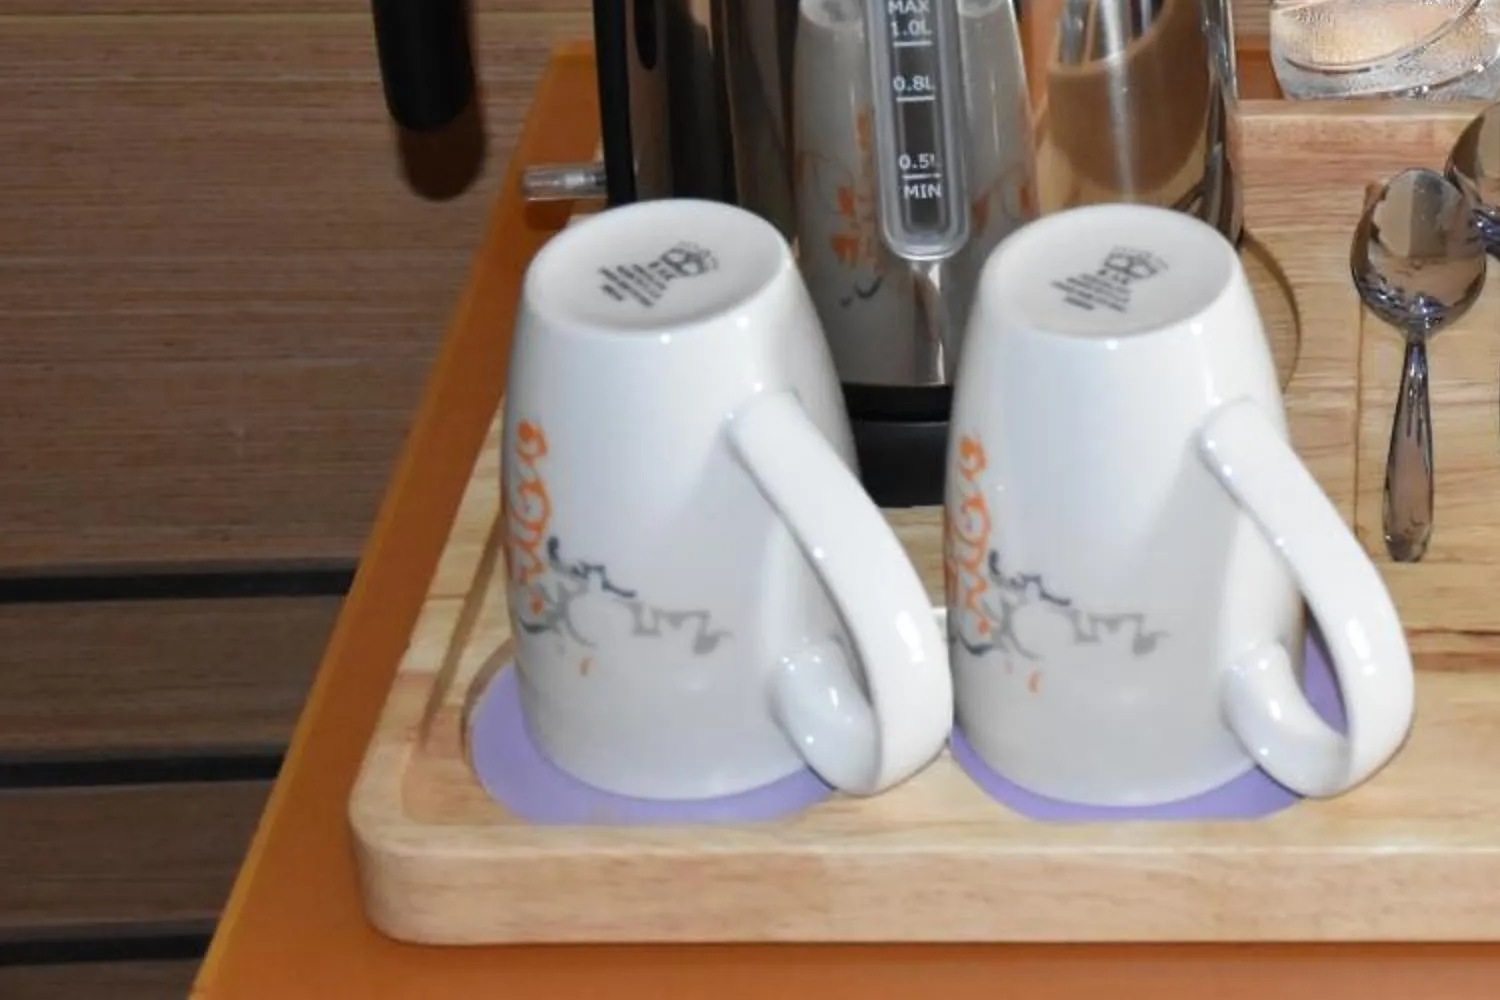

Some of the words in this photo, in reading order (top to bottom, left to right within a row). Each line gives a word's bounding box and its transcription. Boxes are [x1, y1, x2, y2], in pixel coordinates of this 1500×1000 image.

[891, 18, 934, 38] 1.0L
[893, 74, 937, 92] 0.8L
[904, 182, 942, 200] MIN
